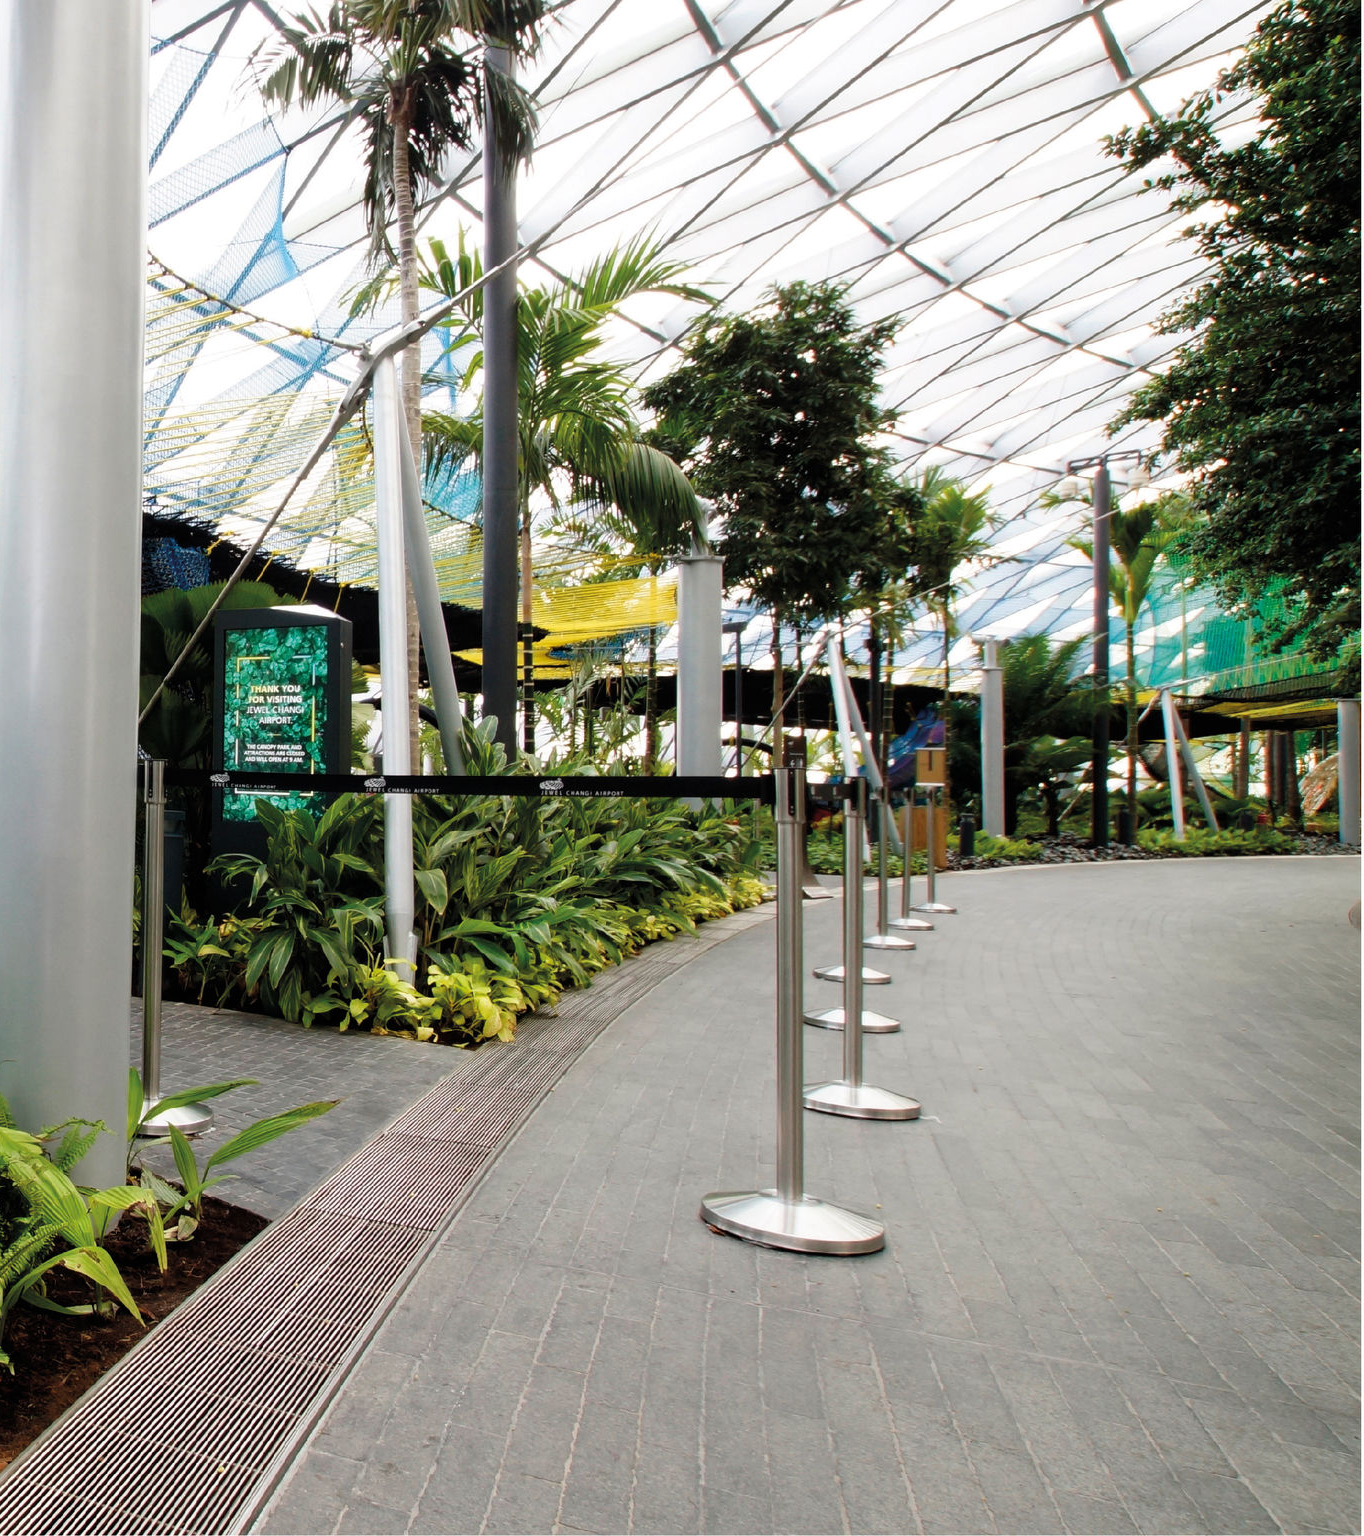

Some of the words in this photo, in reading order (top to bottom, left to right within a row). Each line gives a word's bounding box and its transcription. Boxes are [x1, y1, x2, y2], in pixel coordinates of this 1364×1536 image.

[251, 685, 279, 693] THANK
[281, 685, 301, 693] YOU
[248, 695, 265, 703] FOR
[266, 695, 303, 703] VISITING
[246, 706, 270, 714] JEWEL
[272, 706, 305, 714] CHANGI
[259, 716, 293, 724] AIRPORT.
